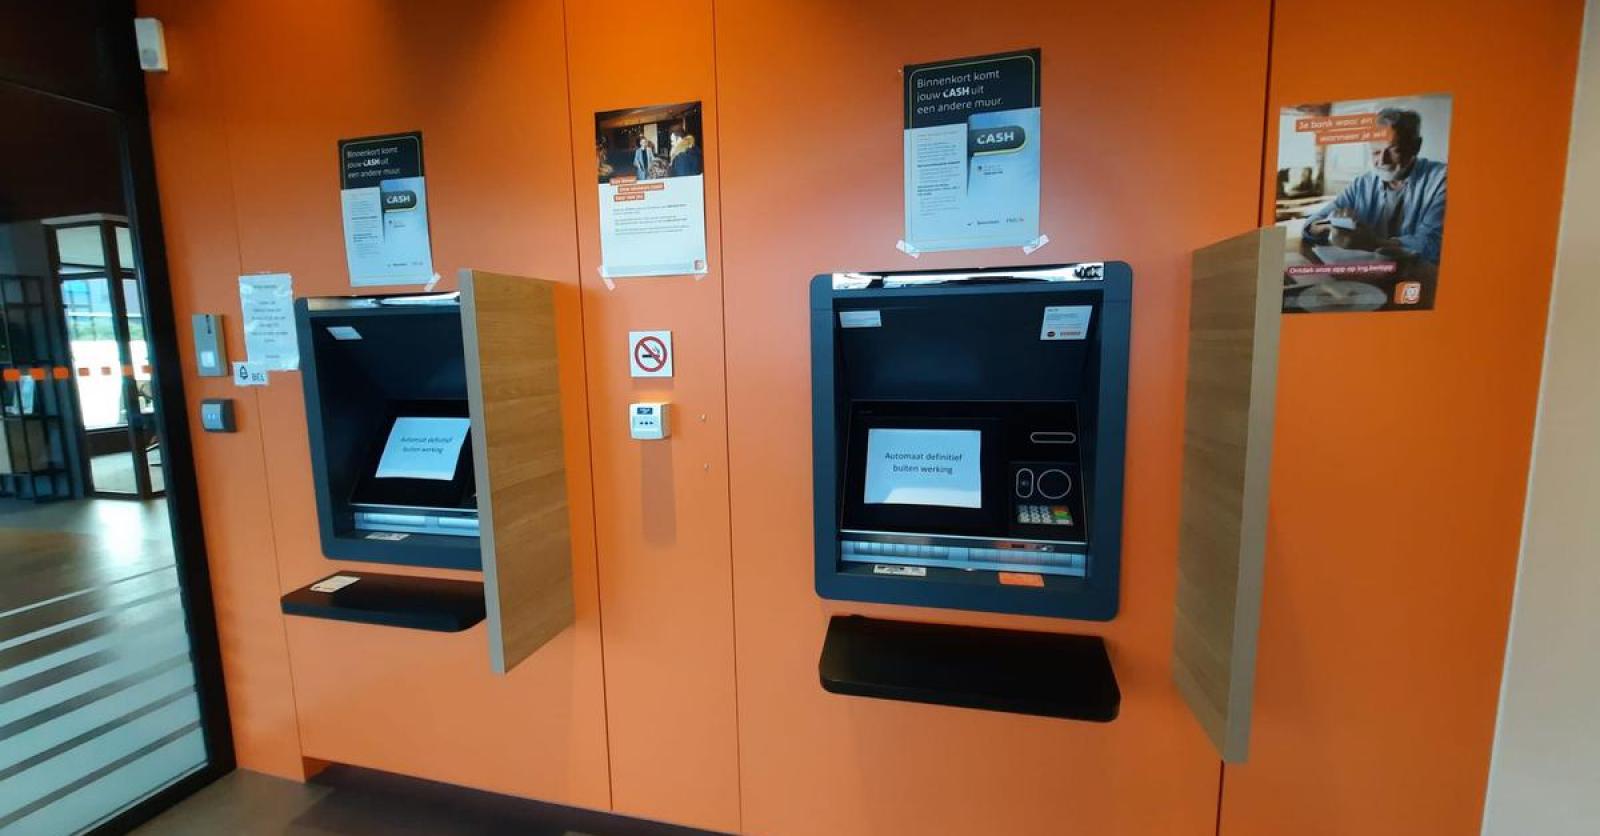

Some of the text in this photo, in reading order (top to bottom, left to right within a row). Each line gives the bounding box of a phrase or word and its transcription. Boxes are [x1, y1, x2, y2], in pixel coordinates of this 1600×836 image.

[917, 70, 1000, 89] Binnenkort komt
[917, 85, 984, 103] jouw CASH uit
[917, 98, 1004, 114] een andere muur.
[977, 131, 1014, 144] CASH
[386, 195, 410, 204] CASH
[885, 452, 963, 463] Automaat definitief
[893, 464, 953, 475] buiten werking
